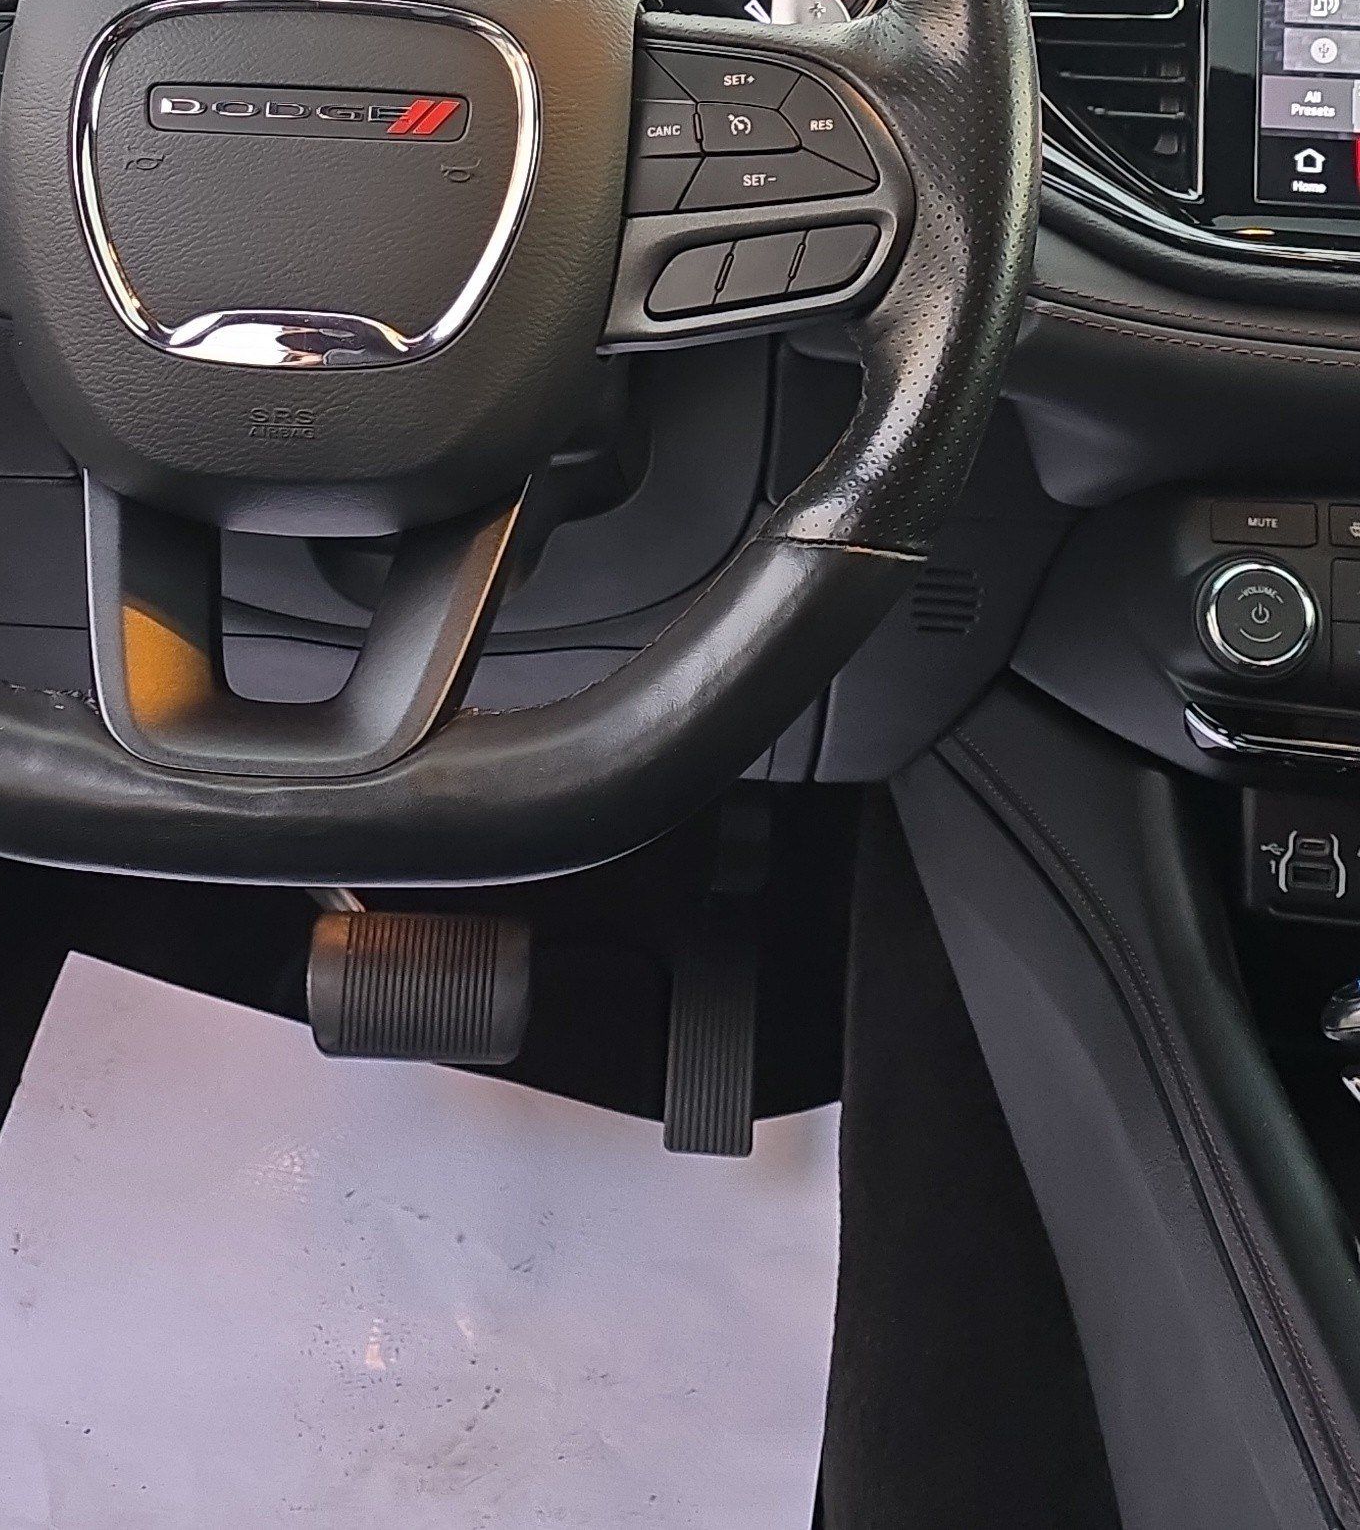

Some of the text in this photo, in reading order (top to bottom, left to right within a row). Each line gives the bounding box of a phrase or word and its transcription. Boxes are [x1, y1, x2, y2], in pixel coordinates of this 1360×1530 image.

[1304, 90, 1321, 104] All
[160, 97, 411, 123] DODGE
[1291, 103, 1335, 119] Presets
[647, 125, 681, 138] CANC
[810, 119, 834, 131] RES
[1292, 180, 1326, 194] Home
[249, 407, 315, 425] SRS
[1247, 516, 1279, 529] MUTE
[1243, 585, 1277, 600] VOLUME
[1269, 859, 1277, 875] 1
